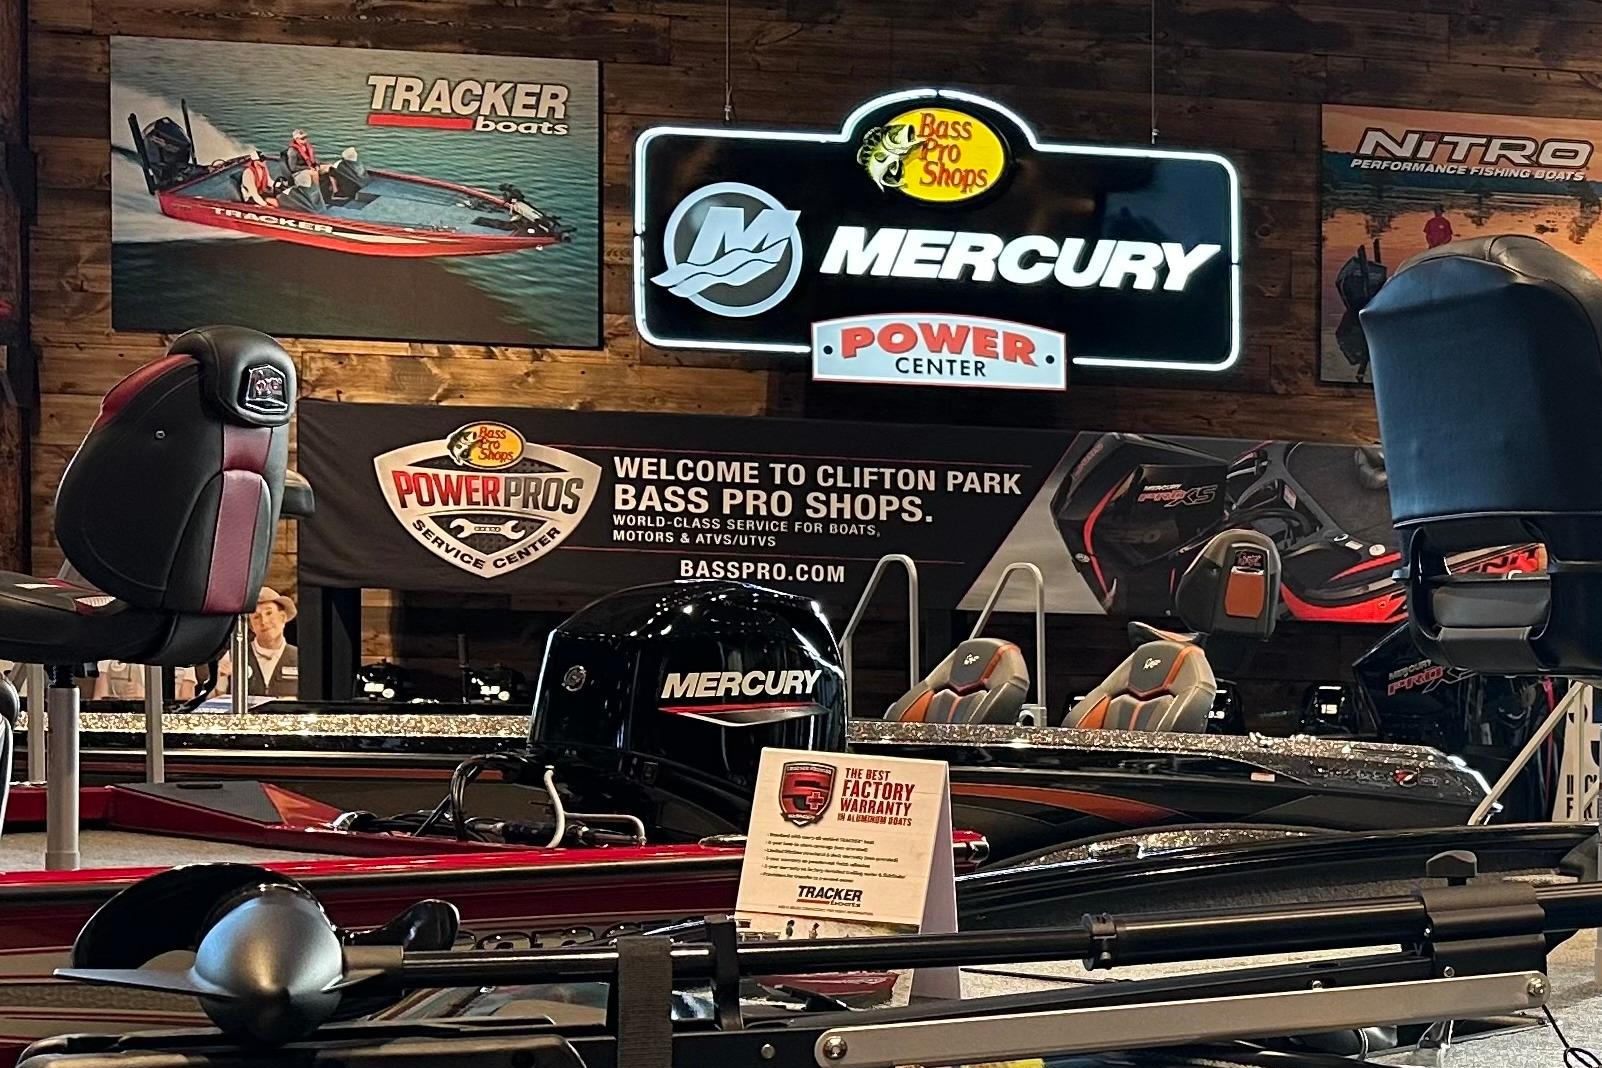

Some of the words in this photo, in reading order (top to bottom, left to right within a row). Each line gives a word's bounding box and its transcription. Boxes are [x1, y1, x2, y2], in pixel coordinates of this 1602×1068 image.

[367, 75, 569, 119] TRACKER
[475, 116, 569, 135] boats
[917, 112, 973, 140] Bass
[918, 137, 962, 164] Pro
[919, 161, 988, 194] Shops
[1350, 158, 1467, 176] PERFORMANCE
[1470, 165, 1531, 180] FISHING
[1534, 169, 1586, 182] BOATS
[211, 206, 333, 233] TRACKER
[818, 225, 1222, 293] MERCURY
[840, 321, 1040, 368] POWER
[894, 356, 987, 379] CENTER
[479, 426, 507, 440] Bass
[479, 436, 501, 450] Pro
[477, 449, 515, 464] Shops
[613, 456, 760, 484] WELCOME
[768, 463, 806, 486] TO
[816, 465, 936, 491] CLIFTON
[946, 470, 1022, 495] PARK
[613, 483, 710, 515] BASS
[721, 488, 794, 517] PRO
[805, 492, 934, 523] SHOPS.
[612, 514, 722, 530] WORLD-CLASS
[726, 518, 789, 533] SERVICE
[793, 521, 824, 535] FOR
[829, 523, 882, 537] BOATS,
[412, 519, 486, 570] SERVICE
[492, 526, 562, 569] CENTER
[612, 529, 675, 545] MOTORS
[680, 532, 691, 544] &
[694, 533, 777, 548] ATVS/UTVS
[679, 559, 846, 583] BASSPRO.COM
[1388, 659, 1432, 681] MERCURY
[661, 669, 822, 699] MERCURY
[1321, 704, 1338, 715] 15
[845, 767, 862, 780] THE
[865, 769, 891, 782] BEST
[841, 778, 916, 802] FACTORY
[840, 797, 913, 817] WARRANTY
[798, 885, 863, 902] TRACKER
